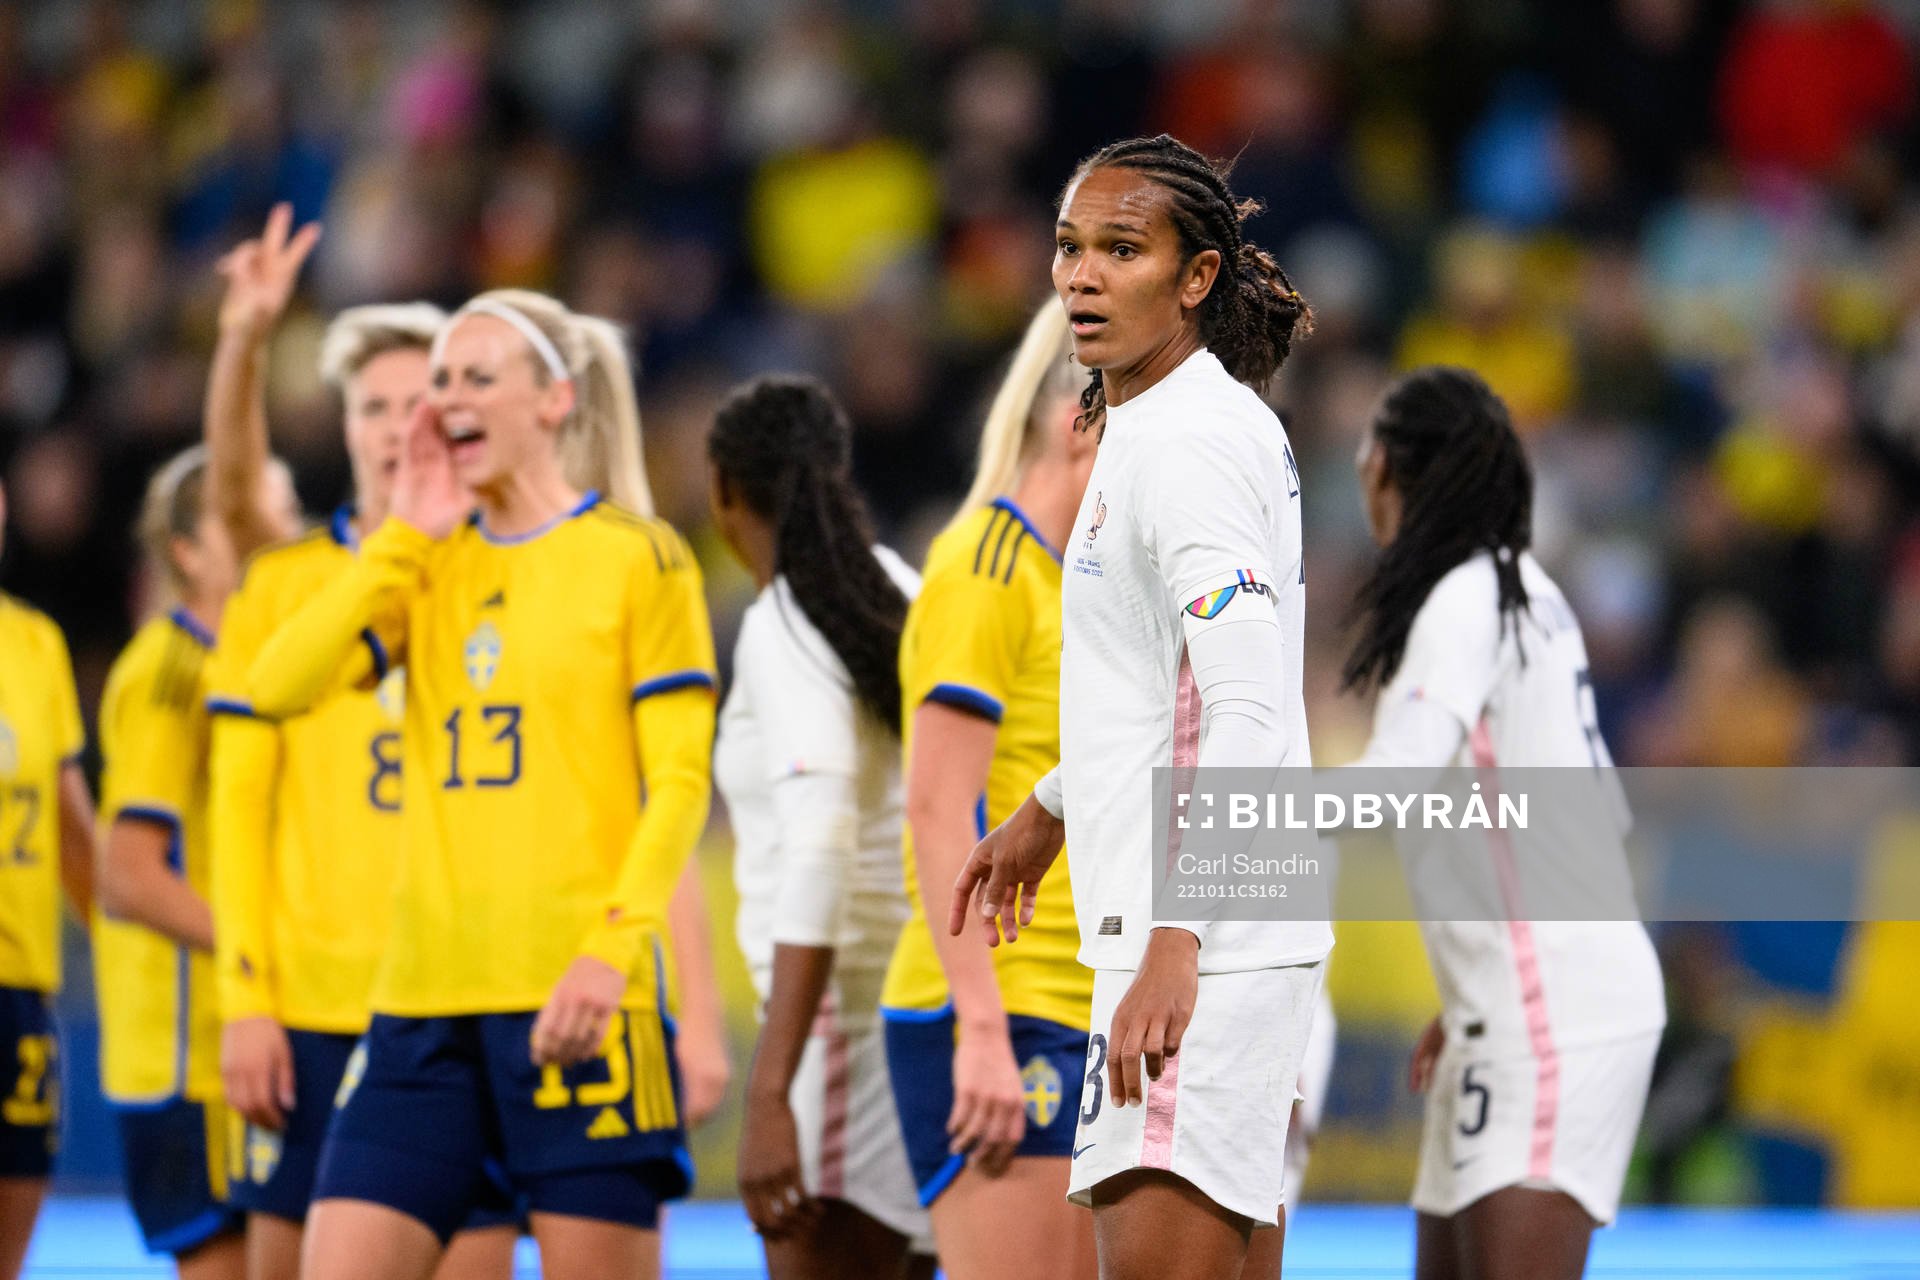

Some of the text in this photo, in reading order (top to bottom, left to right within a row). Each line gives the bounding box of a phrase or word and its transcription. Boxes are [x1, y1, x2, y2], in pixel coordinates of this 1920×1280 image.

[368, 731, 401, 811] 8
[444, 706, 522, 788] 13
[0, 784, 41, 868] 2
[1080, 1033, 1107, 1125] 3
[1459, 1062, 1492, 1136] 5
